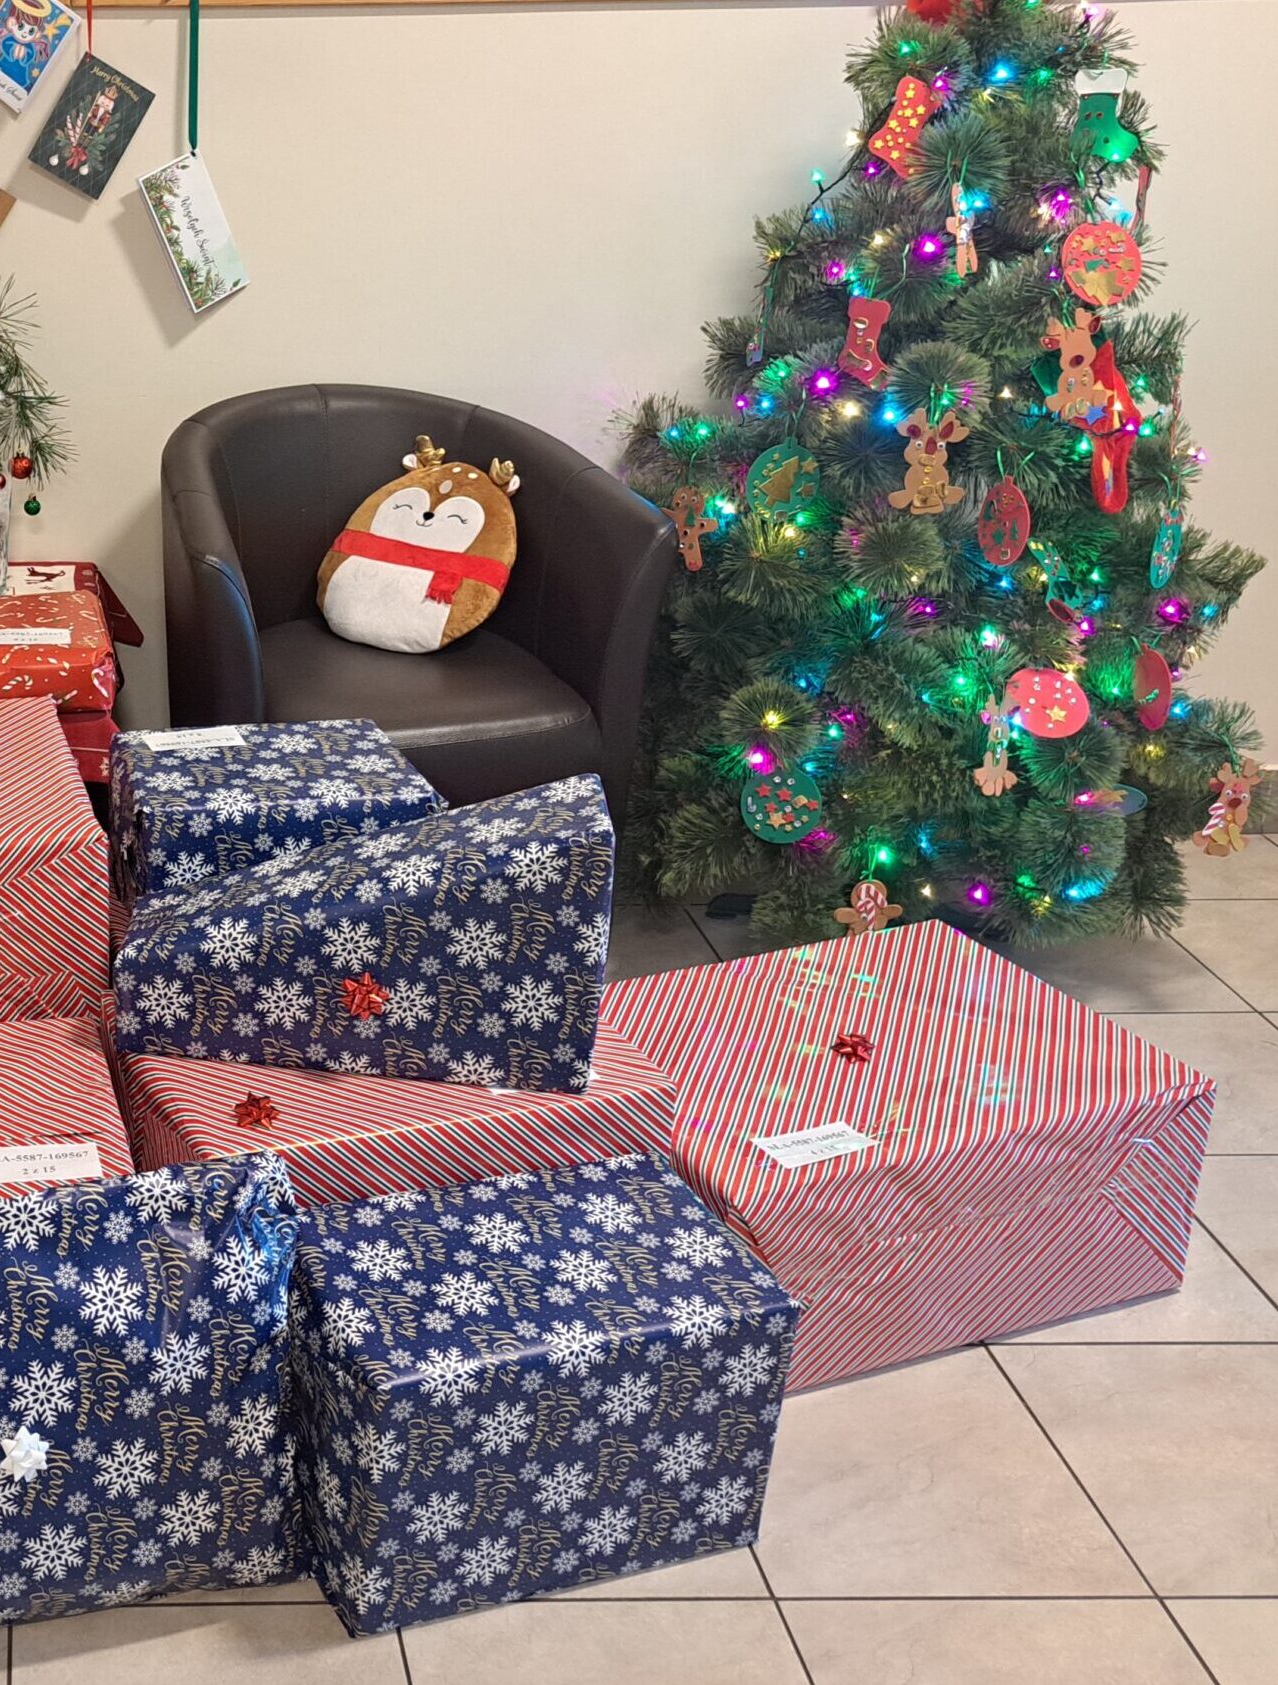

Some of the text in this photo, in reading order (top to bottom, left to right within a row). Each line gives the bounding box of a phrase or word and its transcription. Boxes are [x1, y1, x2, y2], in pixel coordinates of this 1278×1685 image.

[562, 829, 590, 902] Christmas
[257, 900, 279, 968] Christmas
[274, 901, 303, 966] Merry
[380, 896, 407, 968] Christmas
[397, 902, 429, 967] Merry
[505, 896, 532, 966] Christmas
[523, 898, 556, 963] Merry
[189, 967, 212, 1038] Christmas
[207, 971, 238, 1038] Merry
[309, 969, 330, 1039] Christmas
[431, 967, 460, 1040] Christmas
[450, 971, 484, 1038] Merry
[558, 966, 583, 1042] Christmas
[43, 1165, 56, 1173] 15
[54, 1186, 78, 1259] hristmas
[3, 1256, 27, 1353] Christmas
[22, 1260, 58, 1345] Merry
[137, 1230, 162, 1325] Christmas
[153, 1228, 191, 1317] Merry
[227, 1310, 257, 1387] Merry
[74, 1339, 97, 1435] Christmas
[94, 1343, 129, 1427] Merry
[525, 1381, 557, 1459] Christmas
[546, 1383, 581, 1450] Merry
[648, 1353, 680, 1429] Christmas
[667, 1355, 703, 1422] Merry
[157, 1401, 179, 1487] Christmas
[176, 1402, 208, 1477] Merry
[398, 1412, 427, 1489] Christmas
[419, 1413, 454, 1480] Merry
[588, 1430, 617, 1500] Christmas
[607, 1433, 639, 1493] Merry
[708, 1401, 736, 1470] Christmas
[725, 1403, 757, 1463] Merry
[218, 1465, 238, 1546] Christmas
[236, 1466, 265, 1536] Merry
[466, 1461, 493, 1530] Christmas
[485, 1463, 517, 1524] Merry
[628, 1487, 658, 1557] Christmas
[647, 1489, 679, 1552] Merry
[86, 1503, 107, 1584] Christmas
[106, 1506, 139, 1574] Merry
[509, 1517, 537, 1588] Christmas
[527, 1519, 561, 1581] Merry
[383, 1547, 413, 1618] Christmas
[403, 1548, 439, 1611] Merry
